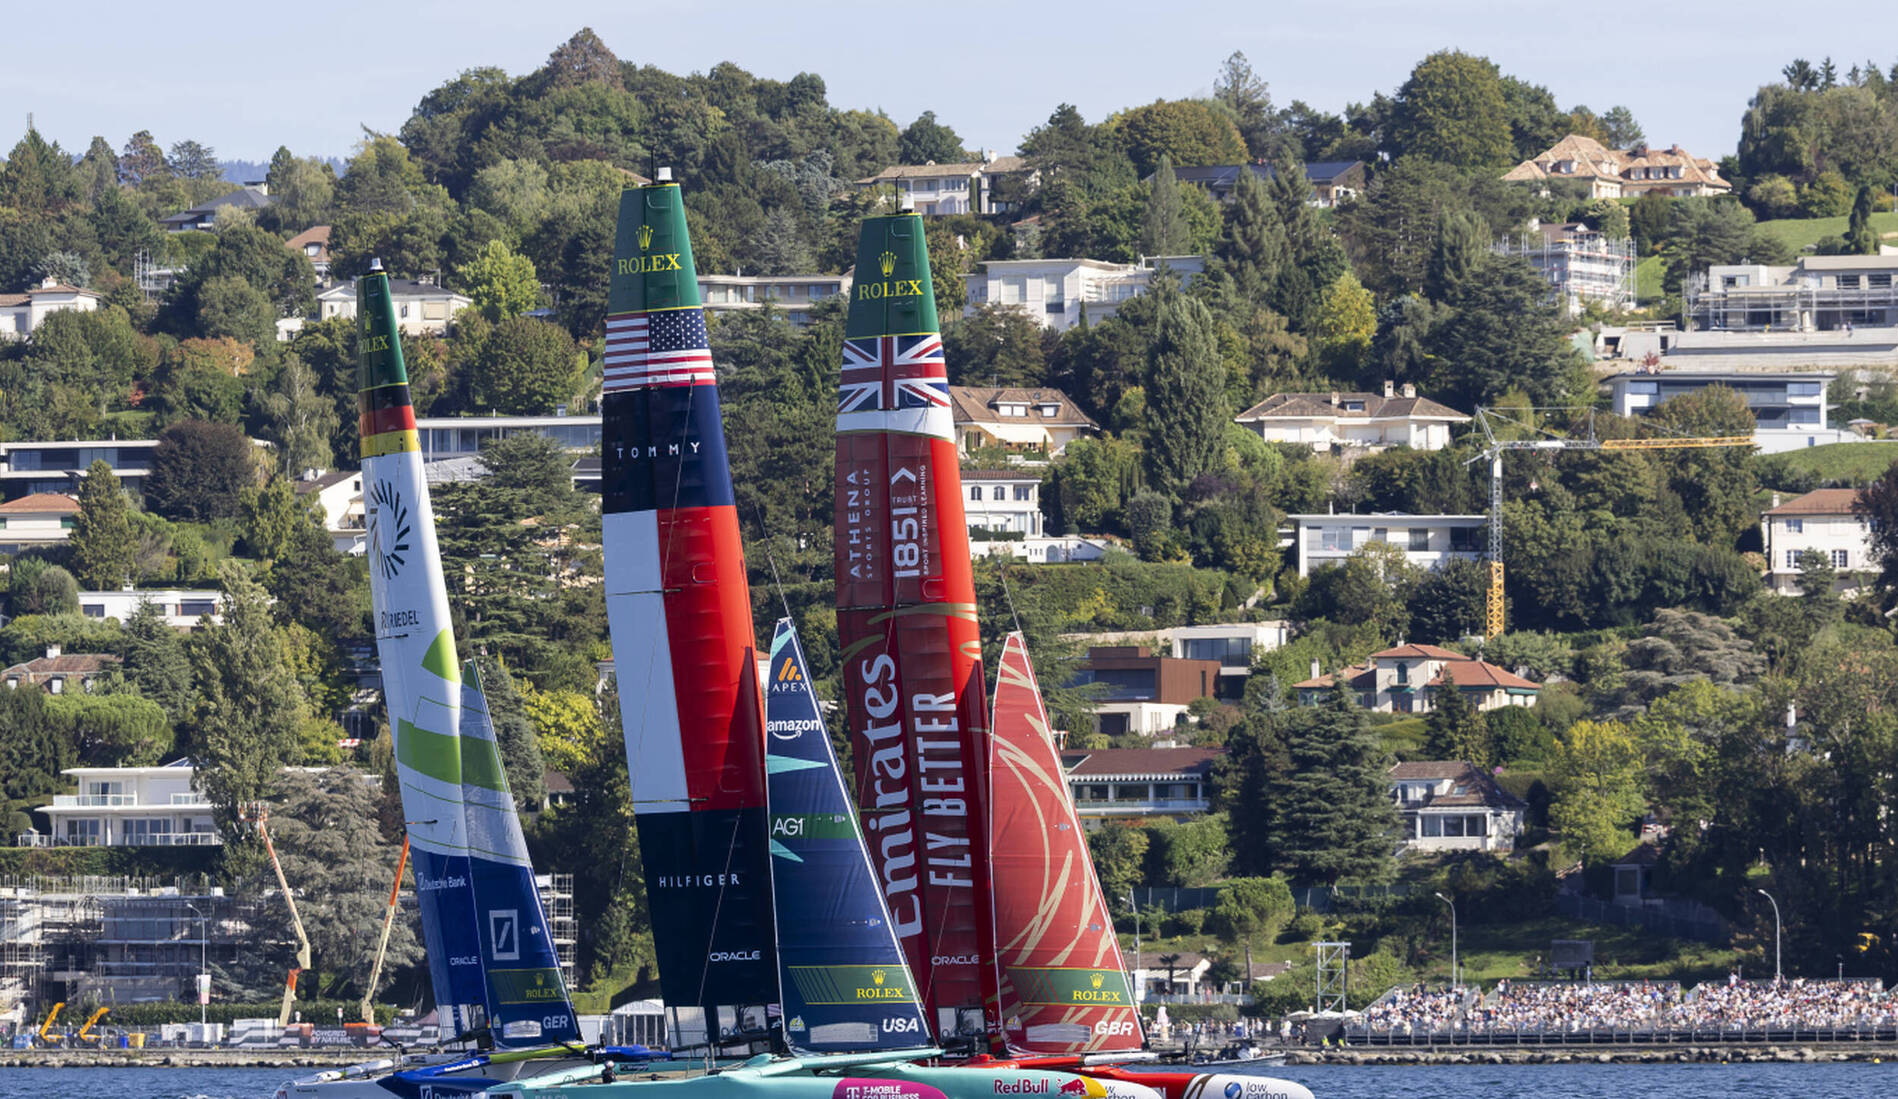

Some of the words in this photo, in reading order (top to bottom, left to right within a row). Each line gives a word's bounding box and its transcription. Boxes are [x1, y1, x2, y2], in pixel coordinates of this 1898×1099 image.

[618, 253, 682, 275] ROLEX
[858, 279, 925, 300] ROLEX
[616, 442, 701, 459] TOMMY
[863, 469, 871, 517] GROUP
[892, 496, 917, 504] TRUST
[847, 471, 862, 579] ATHENA
[865, 526, 873, 579] SPORTS
[773, 682, 807, 693] APEX
[767, 718, 820, 732] amazon
[912, 691, 967, 816] BETTER
[861, 652, 923, 938] Emirates
[773, 818, 805, 836] AG1
[926, 831, 973, 888] FLY
[448, 875, 467, 888] Bank
[659, 873, 740, 888] HILFIGER
[450, 955, 478, 966] ORACLE
[709, 950, 761, 962] ORACLE
[931, 954, 980, 966] ORACLE
[526, 987, 559, 999] ROLEX
[856, 987, 904, 999] ROLEX
[1072, 990, 1121, 1002] ROLEX
[543, 1016, 568, 1029] GER
[882, 1017, 919, 1033] USA
[1094, 1021, 1134, 1036] GBR
[863, 1085, 902, 1095] T-MOBILE
[994, 1078, 1020, 1094] Red
[1022, 1078, 1048, 1094] Bull
[1246, 1081, 1268, 1092] low
